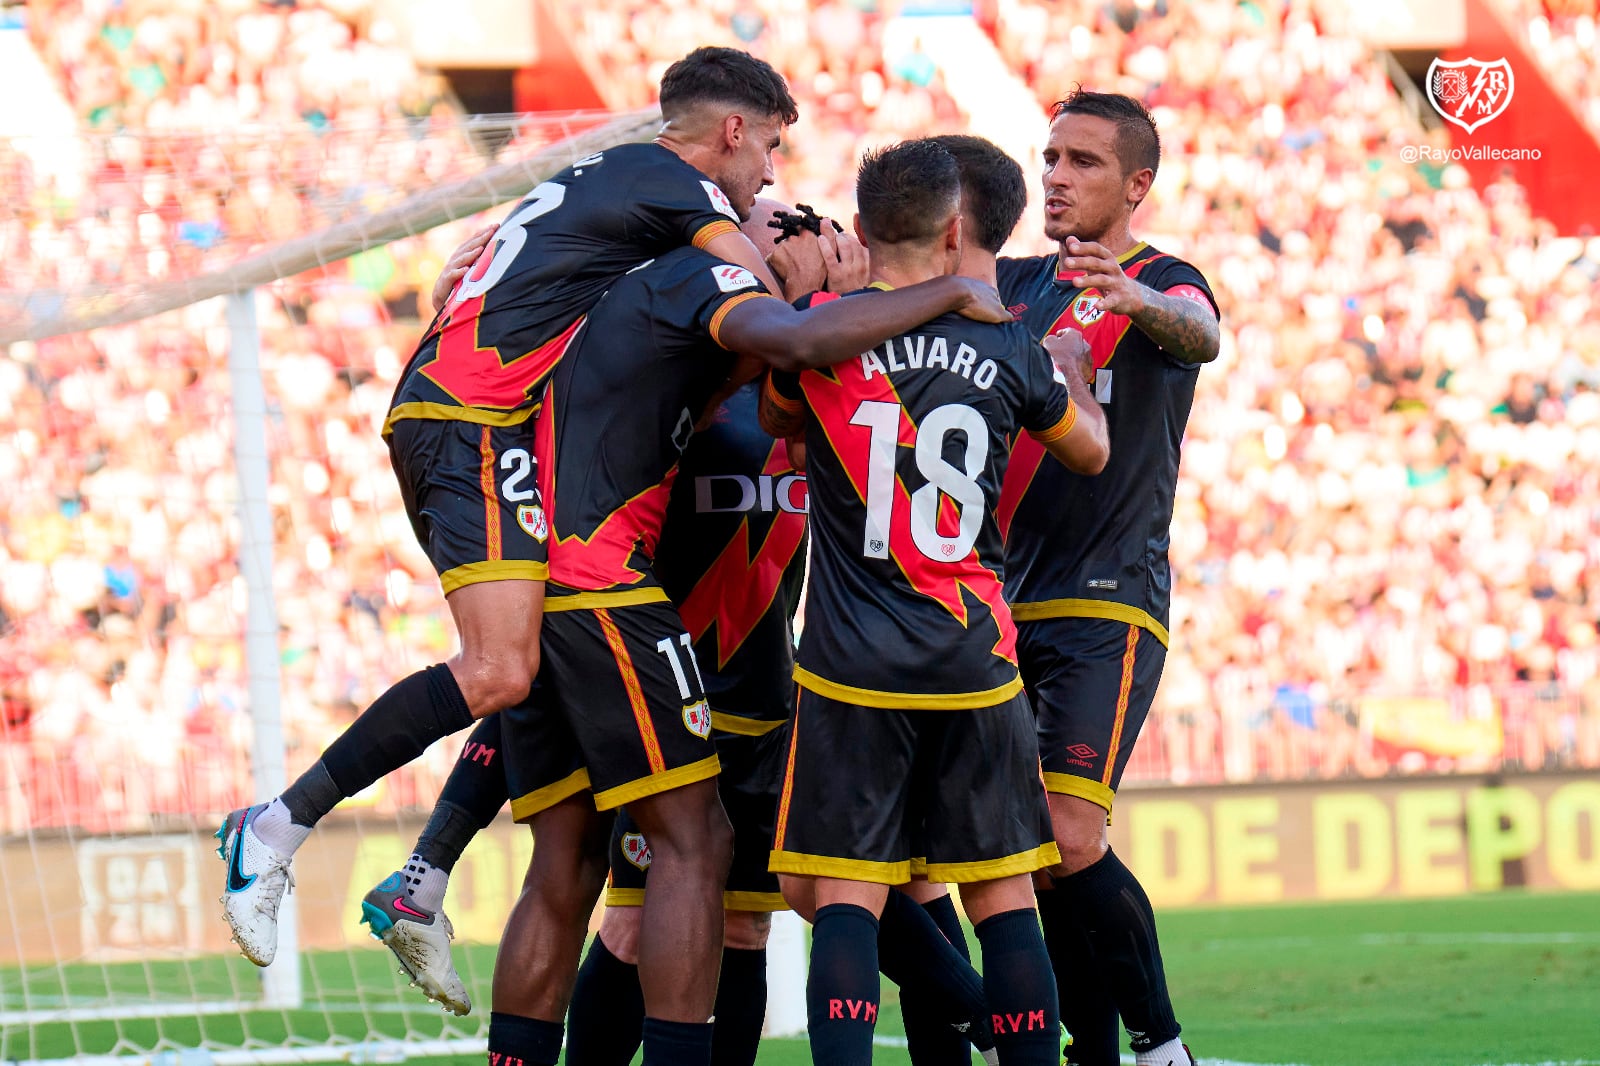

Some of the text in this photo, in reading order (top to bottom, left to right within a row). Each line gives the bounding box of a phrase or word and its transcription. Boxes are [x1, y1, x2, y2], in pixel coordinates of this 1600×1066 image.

[860, 335, 998, 390] ALVARO
[501, 448, 543, 502] 2
[849, 400, 989, 563] 18
[1066, 757, 1093, 769] umbro
[1129, 796, 1285, 906] DE
[829, 999, 877, 1024] RVM
[992, 1009, 1045, 1034] RVM
